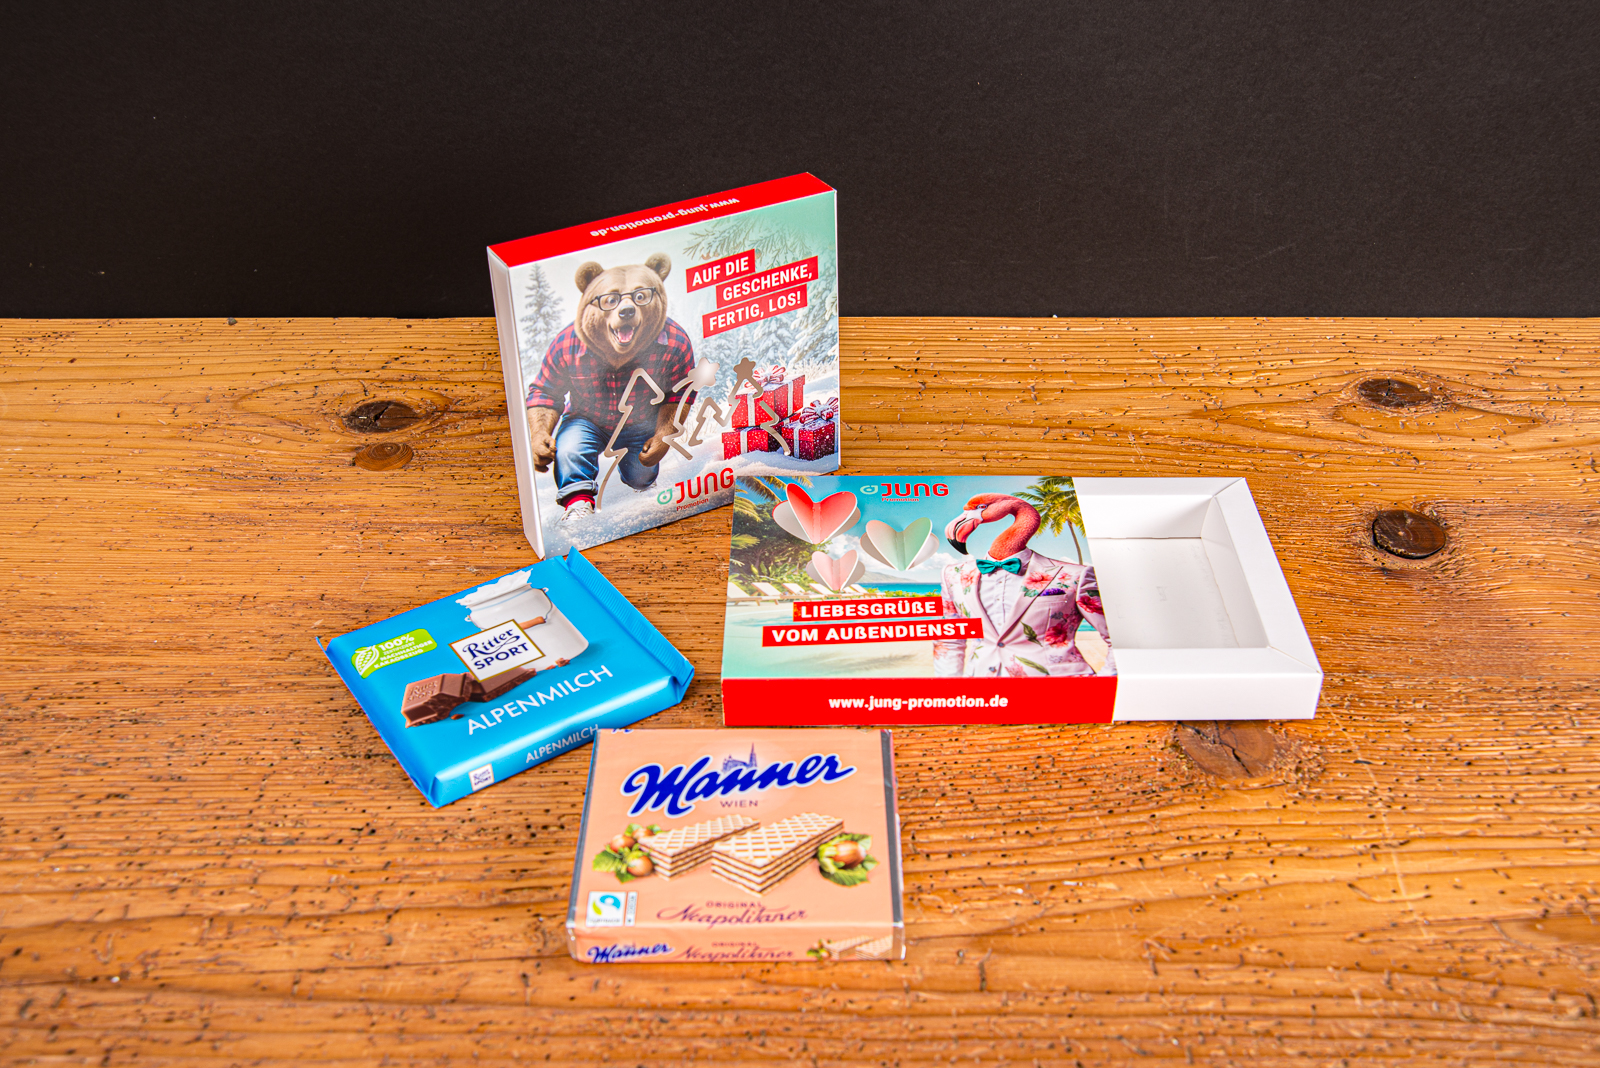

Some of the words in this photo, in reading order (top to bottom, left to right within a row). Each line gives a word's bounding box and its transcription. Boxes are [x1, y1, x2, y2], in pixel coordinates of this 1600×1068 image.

[589, 197, 740, 237] www.jung-promotion.de
[692, 267, 720, 287] AUF
[725, 257, 749, 277] DIE
[722, 263, 813, 302] GESCHENKE,
[709, 304, 765, 332] FERTIG,
[768, 291, 802, 313] LOS!
[674, 467, 735, 504] JUNG
[881, 483, 949, 497] JUNG
[676, 498, 709, 512] Promotion
[378, 634, 415, 651] 100%
[462, 629, 520, 661] Ritter
[772, 628, 819, 643] VOM
[474, 642, 529, 670] SPORT
[467, 664, 614, 735] ALPENMILCH
[828, 694, 1009, 711] www.jung-promotion.de
[525, 723, 600, 763] ALPENMILCH
[621, 754, 855, 817] Manner
[719, 799, 759, 808] WIEN
[656, 903, 806, 930] Neapolitaner
[705, 901, 762, 909] ORIGINAL
[587, 943, 674, 964] Manner
